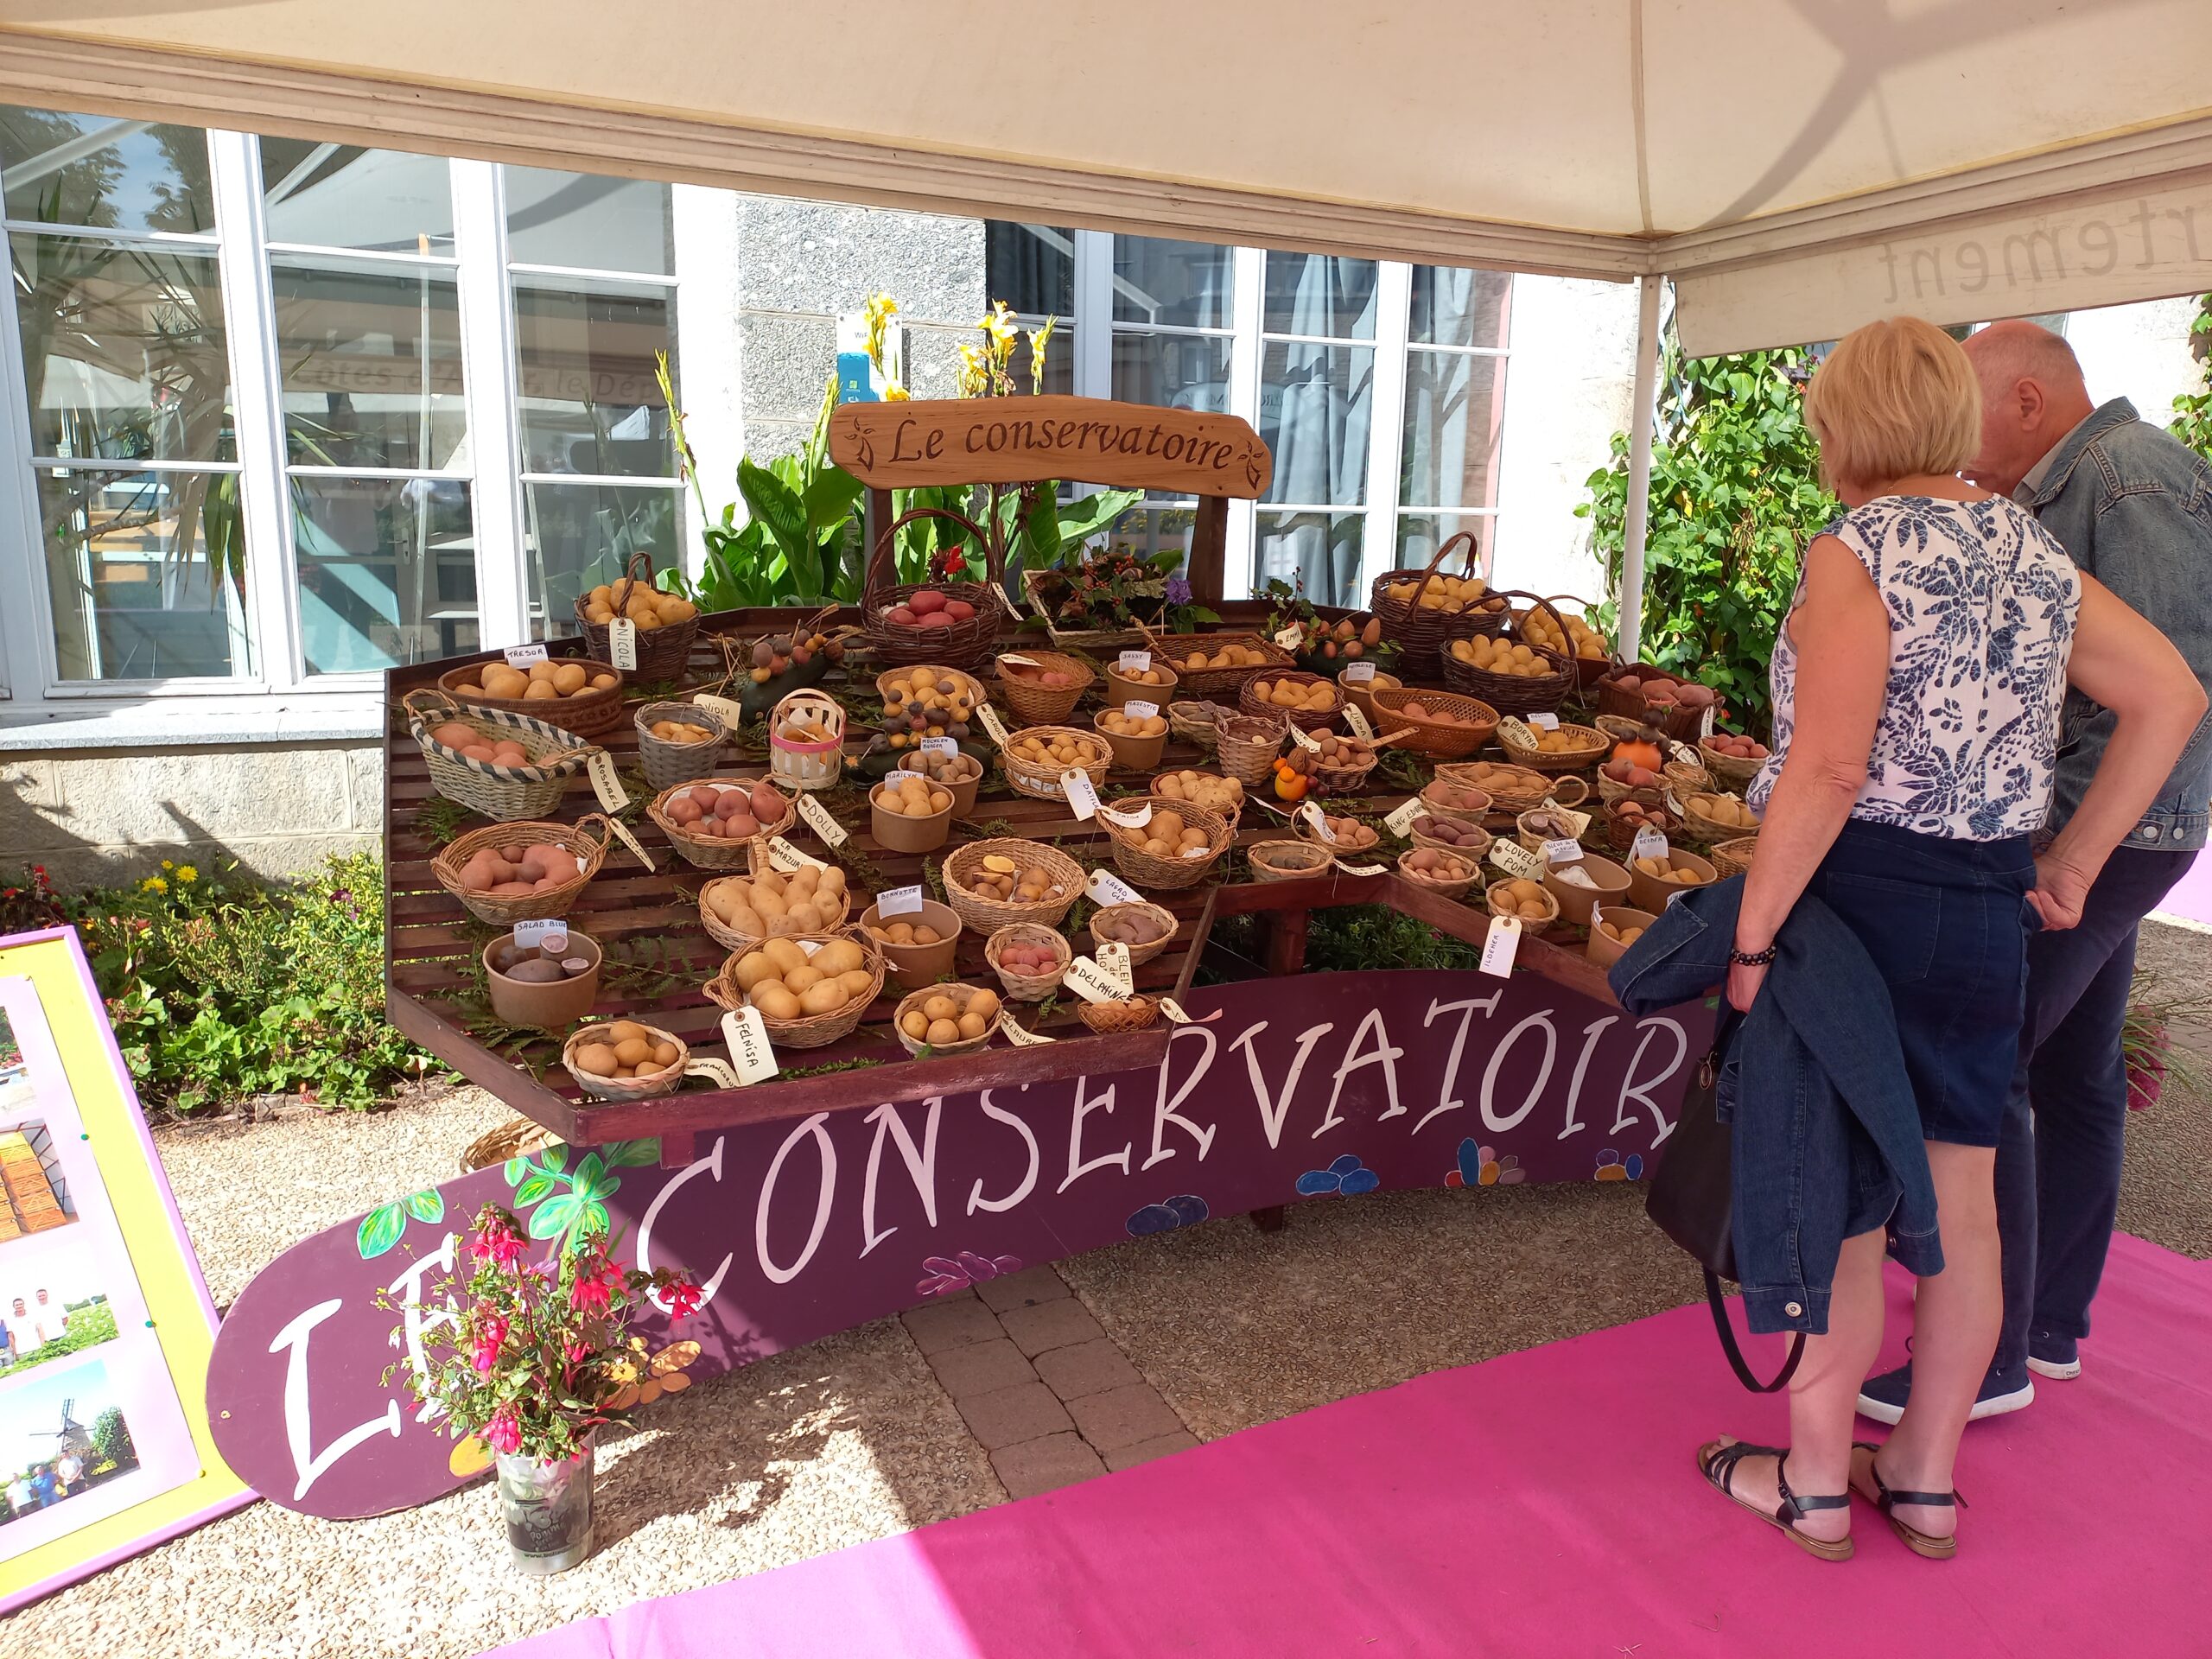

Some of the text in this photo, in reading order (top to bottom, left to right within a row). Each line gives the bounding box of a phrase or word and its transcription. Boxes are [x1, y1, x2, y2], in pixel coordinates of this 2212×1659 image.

[888, 418, 1233, 470] Le conservatoire
[508, 649, 544, 658] TRESOR
[1510, 721, 1537, 749] BORYNA
[598, 764, 618, 808] ROSABEL
[805, 804, 842, 840] DOLLY
[1389, 817, 1406, 831] KING
[780, 841, 791, 851] LA
[1503, 842, 1543, 867] LOVELY
[1503, 858, 1528, 877] POM
[518, 921, 546, 931] SALAD
